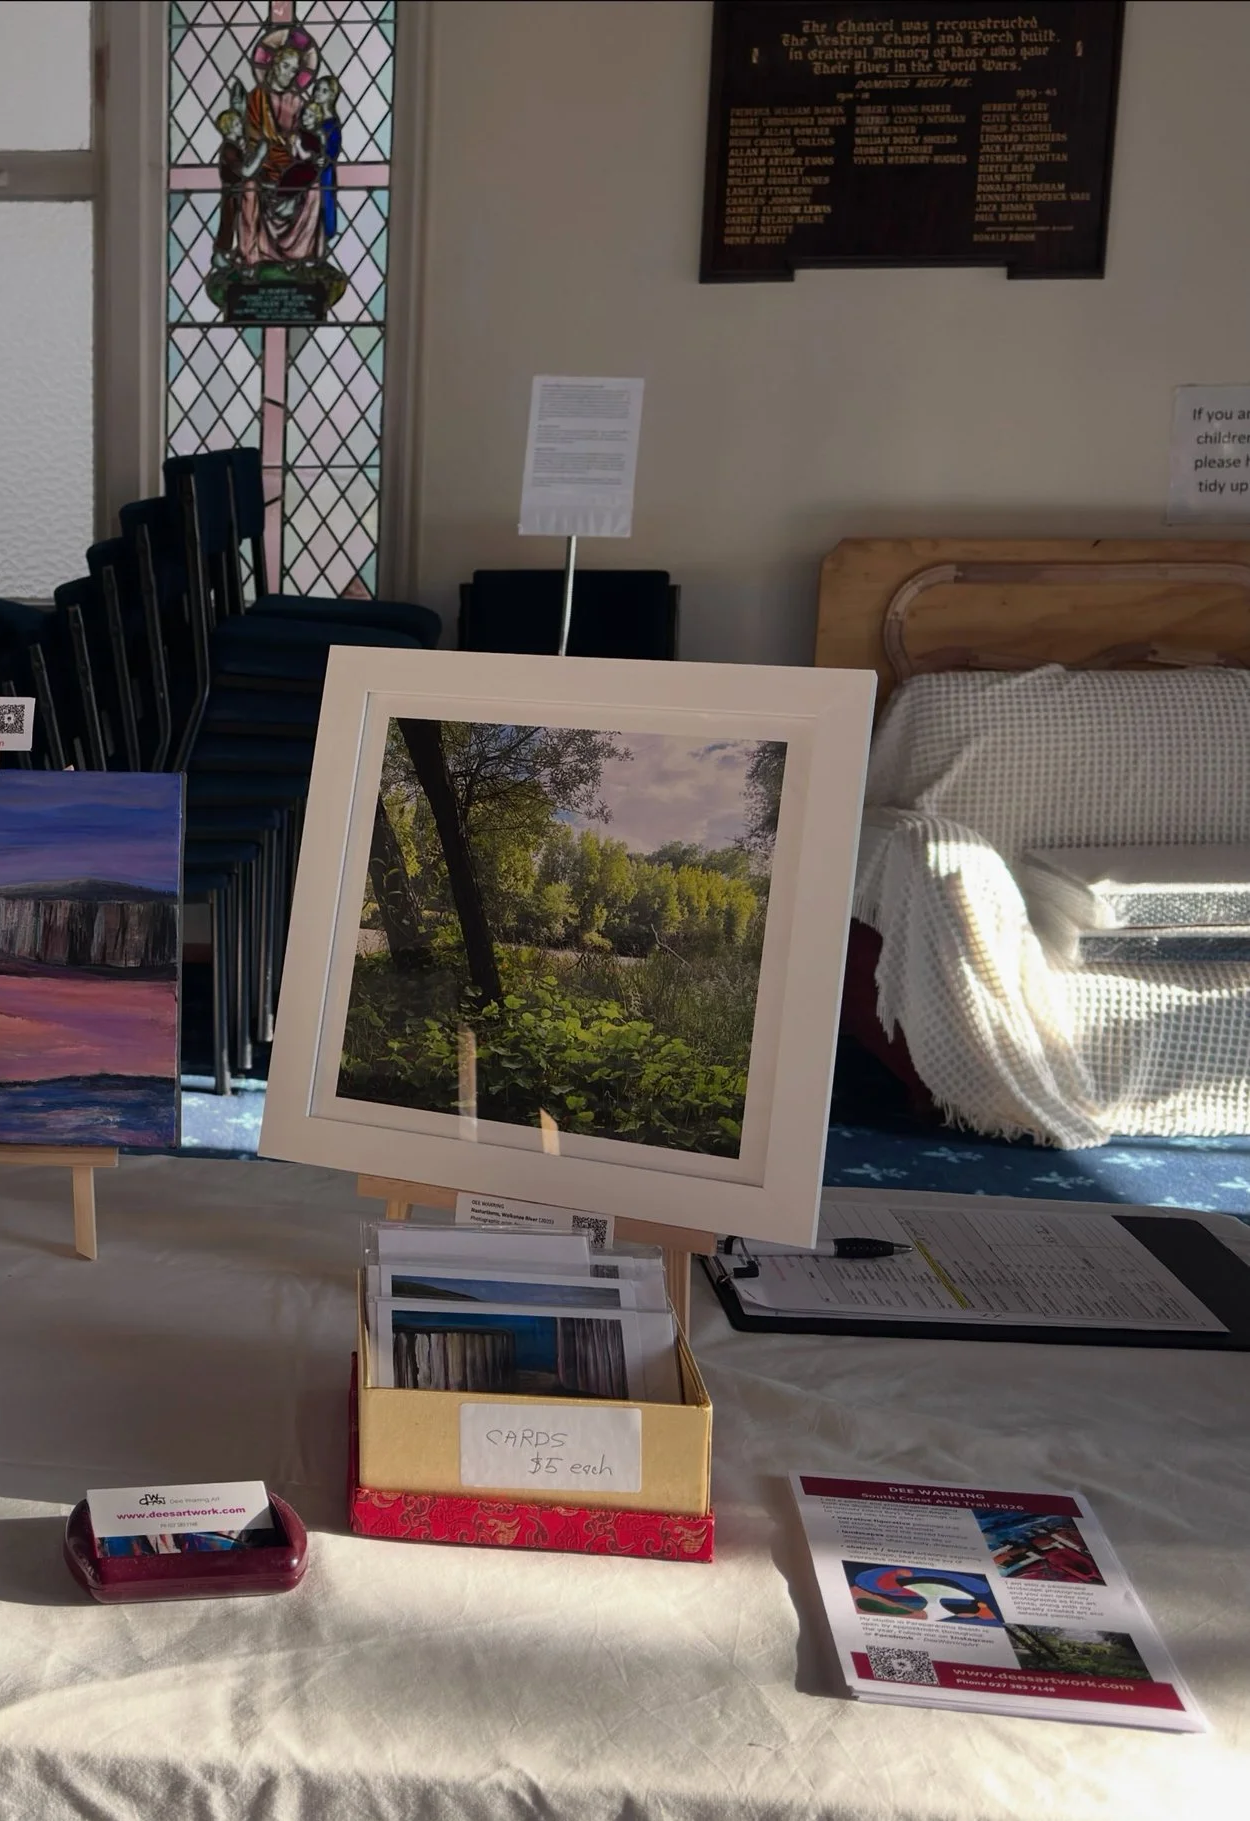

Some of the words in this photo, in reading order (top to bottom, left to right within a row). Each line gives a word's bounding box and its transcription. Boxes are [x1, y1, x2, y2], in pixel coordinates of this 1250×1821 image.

[802, 20, 827, 33] The
[836, 19, 894, 32] Chancel
[901, 21, 929, 31] was
[935, 16, 1038, 31] reconstructed
[781, 33, 809, 46] The
[815, 32, 874, 46] Vestries
[882, 32, 930, 46] Chapel
[937, 31, 963, 44] and
[970, 31, 1014, 45] Porch
[872, 46, 929, 61] Memory
[933, 46, 946, 60] of
[951, 45, 985, 58] those
[989, 45, 1016, 57] who
[1020, 46, 1050, 60] gave
[812, 61, 849, 76] Their
[853, 61, 889, 75] Lives
[893, 60, 907, 73] in
[911, 60, 933, 73] the
[936, 59, 976, 72] World
[981, 60, 1022, 72] Wars.
[796, 136, 835, 147] COLLINS
[854, 134, 890, 144] WILLIAM
[979, 143, 1002, 152] JACK
[728, 156, 766, 167] WILLIAM
[805, 156, 834, 167] EVANS
[727, 166, 766, 176] WILLIAM
[727, 176, 765, 185] WILLIAM
[803, 205, 831, 214] LEWIS
[1193, 407, 1203, 420] If
[1207, 410, 1233, 423] you
[1194, 454, 1241, 471] please
[1198, 479, 1226, 495] tidy
[1230, 481, 1249, 495] up
[486, 1428, 568, 1448] CARDS
[528, 1452, 563, 1474] $5
[570, 1454, 613, 1476] each
[861, 1492, 895, 1501] South
[899, 1495, 933, 1503] Coast
[936, 1498, 960, 1506] Arts
[963, 1500, 990, 1508] Trail
[994, 1503, 1025, 1511] 2026
[918, 1489, 986, 1500] WARRING
[117, 1506, 246, 1520] www.deesartwork.com
[950, 1635, 994, 1644] Instagram
[953, 1668, 1135, 1691] www.deesartwork.com
[956, 1678, 987, 1686] Phone
[1030, 1685, 1055, 1693] 7148
